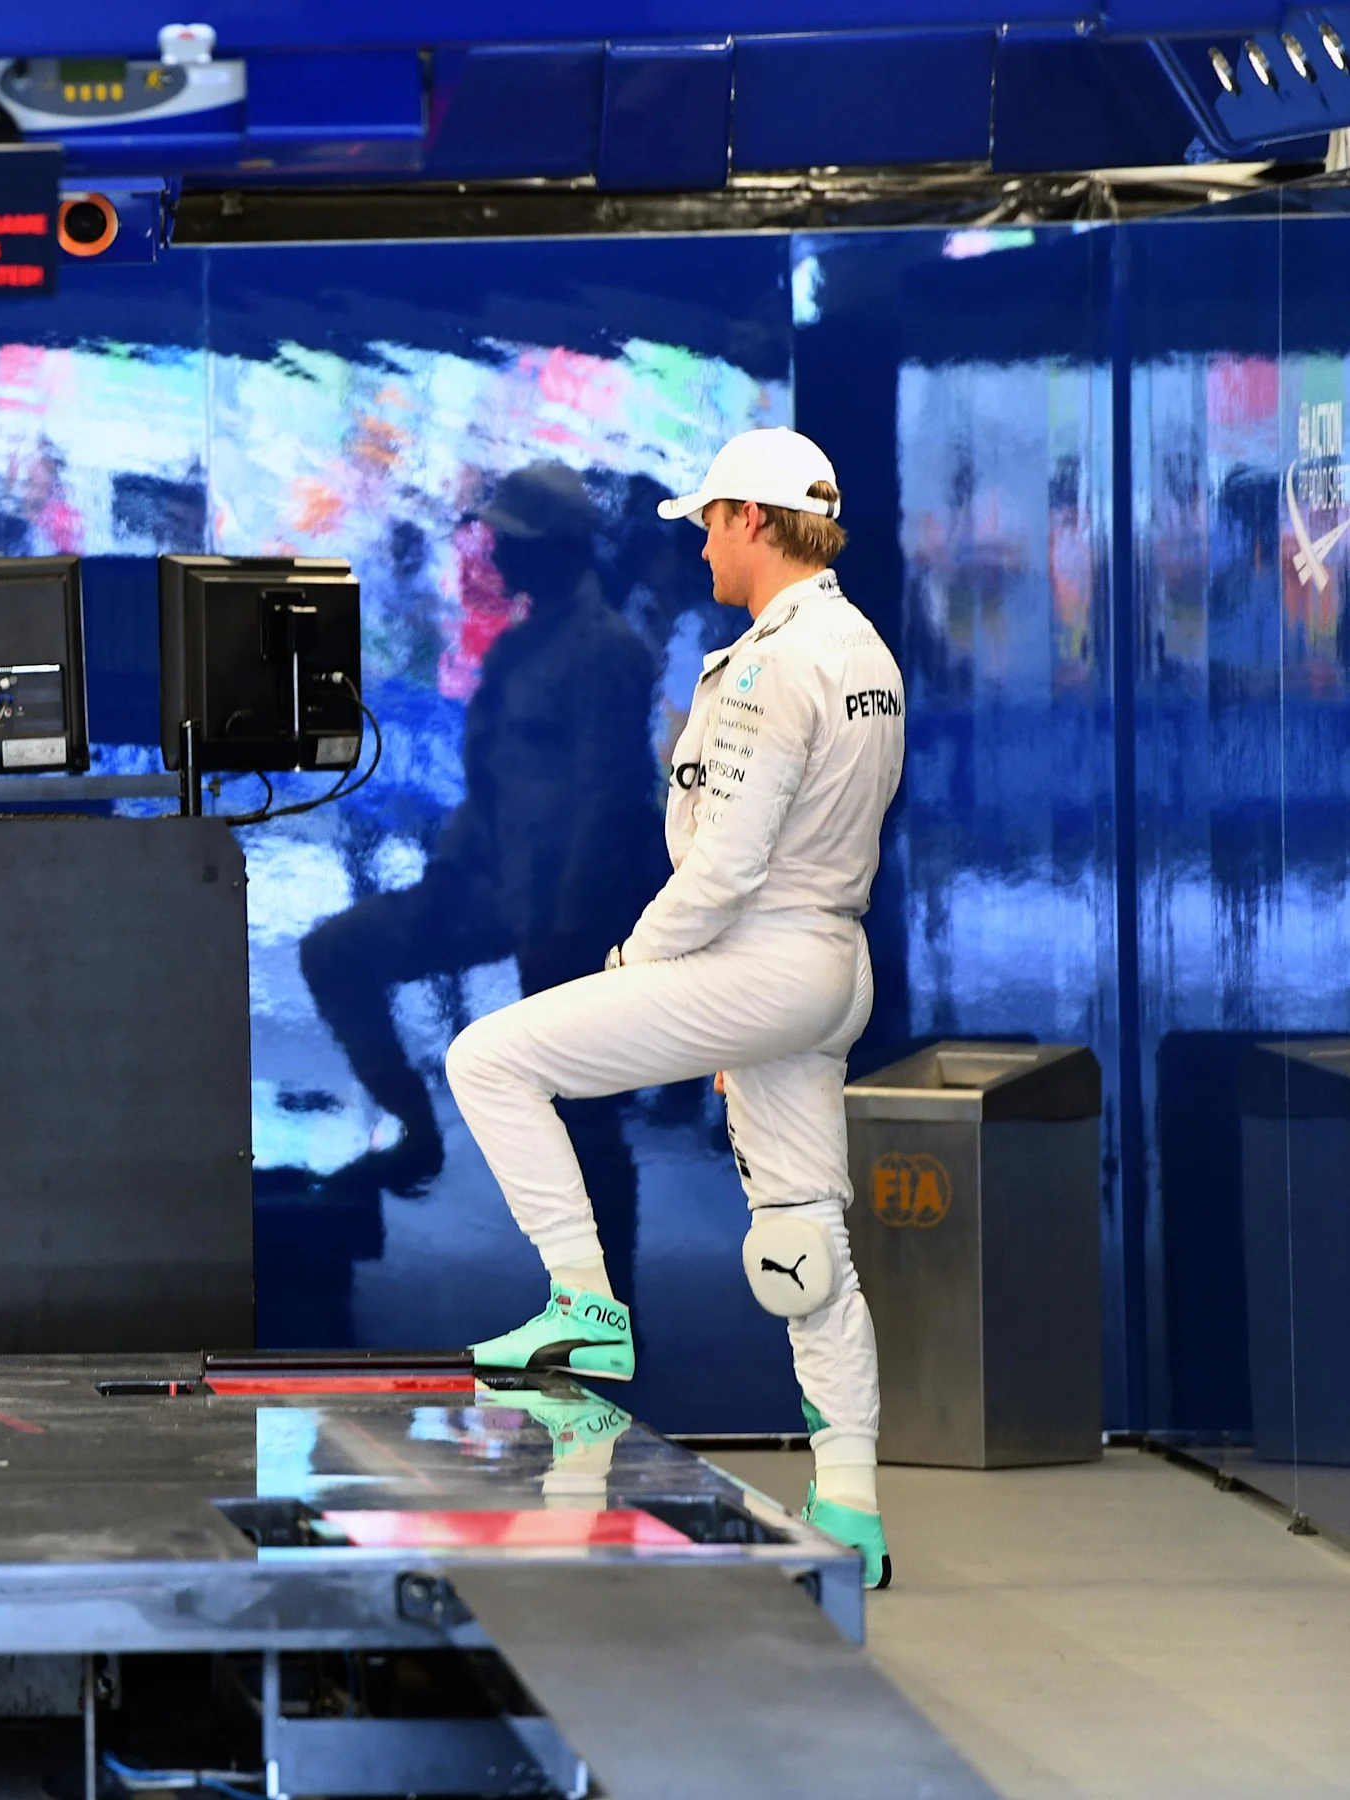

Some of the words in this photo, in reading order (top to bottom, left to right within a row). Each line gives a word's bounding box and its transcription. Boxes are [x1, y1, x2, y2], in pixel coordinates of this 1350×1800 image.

[708, 758, 746, 783] EPSON
[874, 1168, 944, 1214] FIA
[584, 1304, 627, 1332] nico
